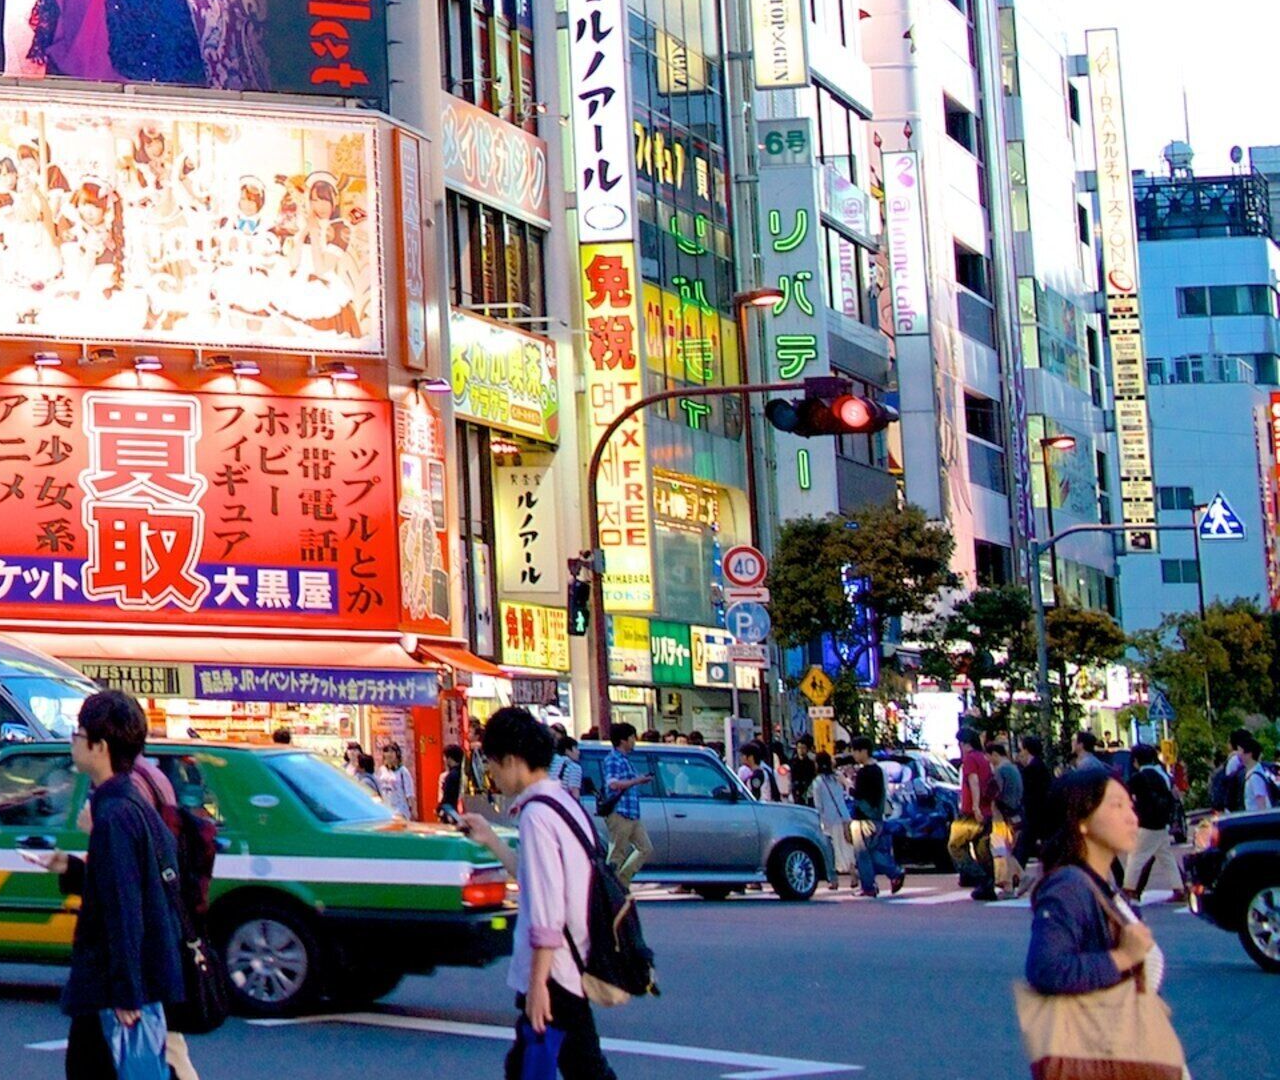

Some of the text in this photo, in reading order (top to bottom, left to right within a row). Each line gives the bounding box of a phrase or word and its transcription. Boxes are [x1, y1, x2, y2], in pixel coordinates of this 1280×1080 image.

[765, 130, 805, 159] 6号
[585, 254, 637, 372] 免税
[768, 208, 817, 491] リバテー
[32, 394, 77, 553] 美少女系
[82, 395, 208, 608] 買取
[211, 404, 255, 558] フィギュア
[253, 407, 291, 517] ホビー
[297, 407, 338, 564] 携帯電話
[339, 411, 384, 615] アップルとか
[618, 381, 648, 548] TAX FREE
[213, 568, 334, 610] 大黒屋
[517, 490, 542, 586] ルノアール
[734, 557, 757, 578] 40
[83, 666, 164, 681] WESTERN
[651, 635, 691, 667] リバティー
[736, 612, 752, 638] P
